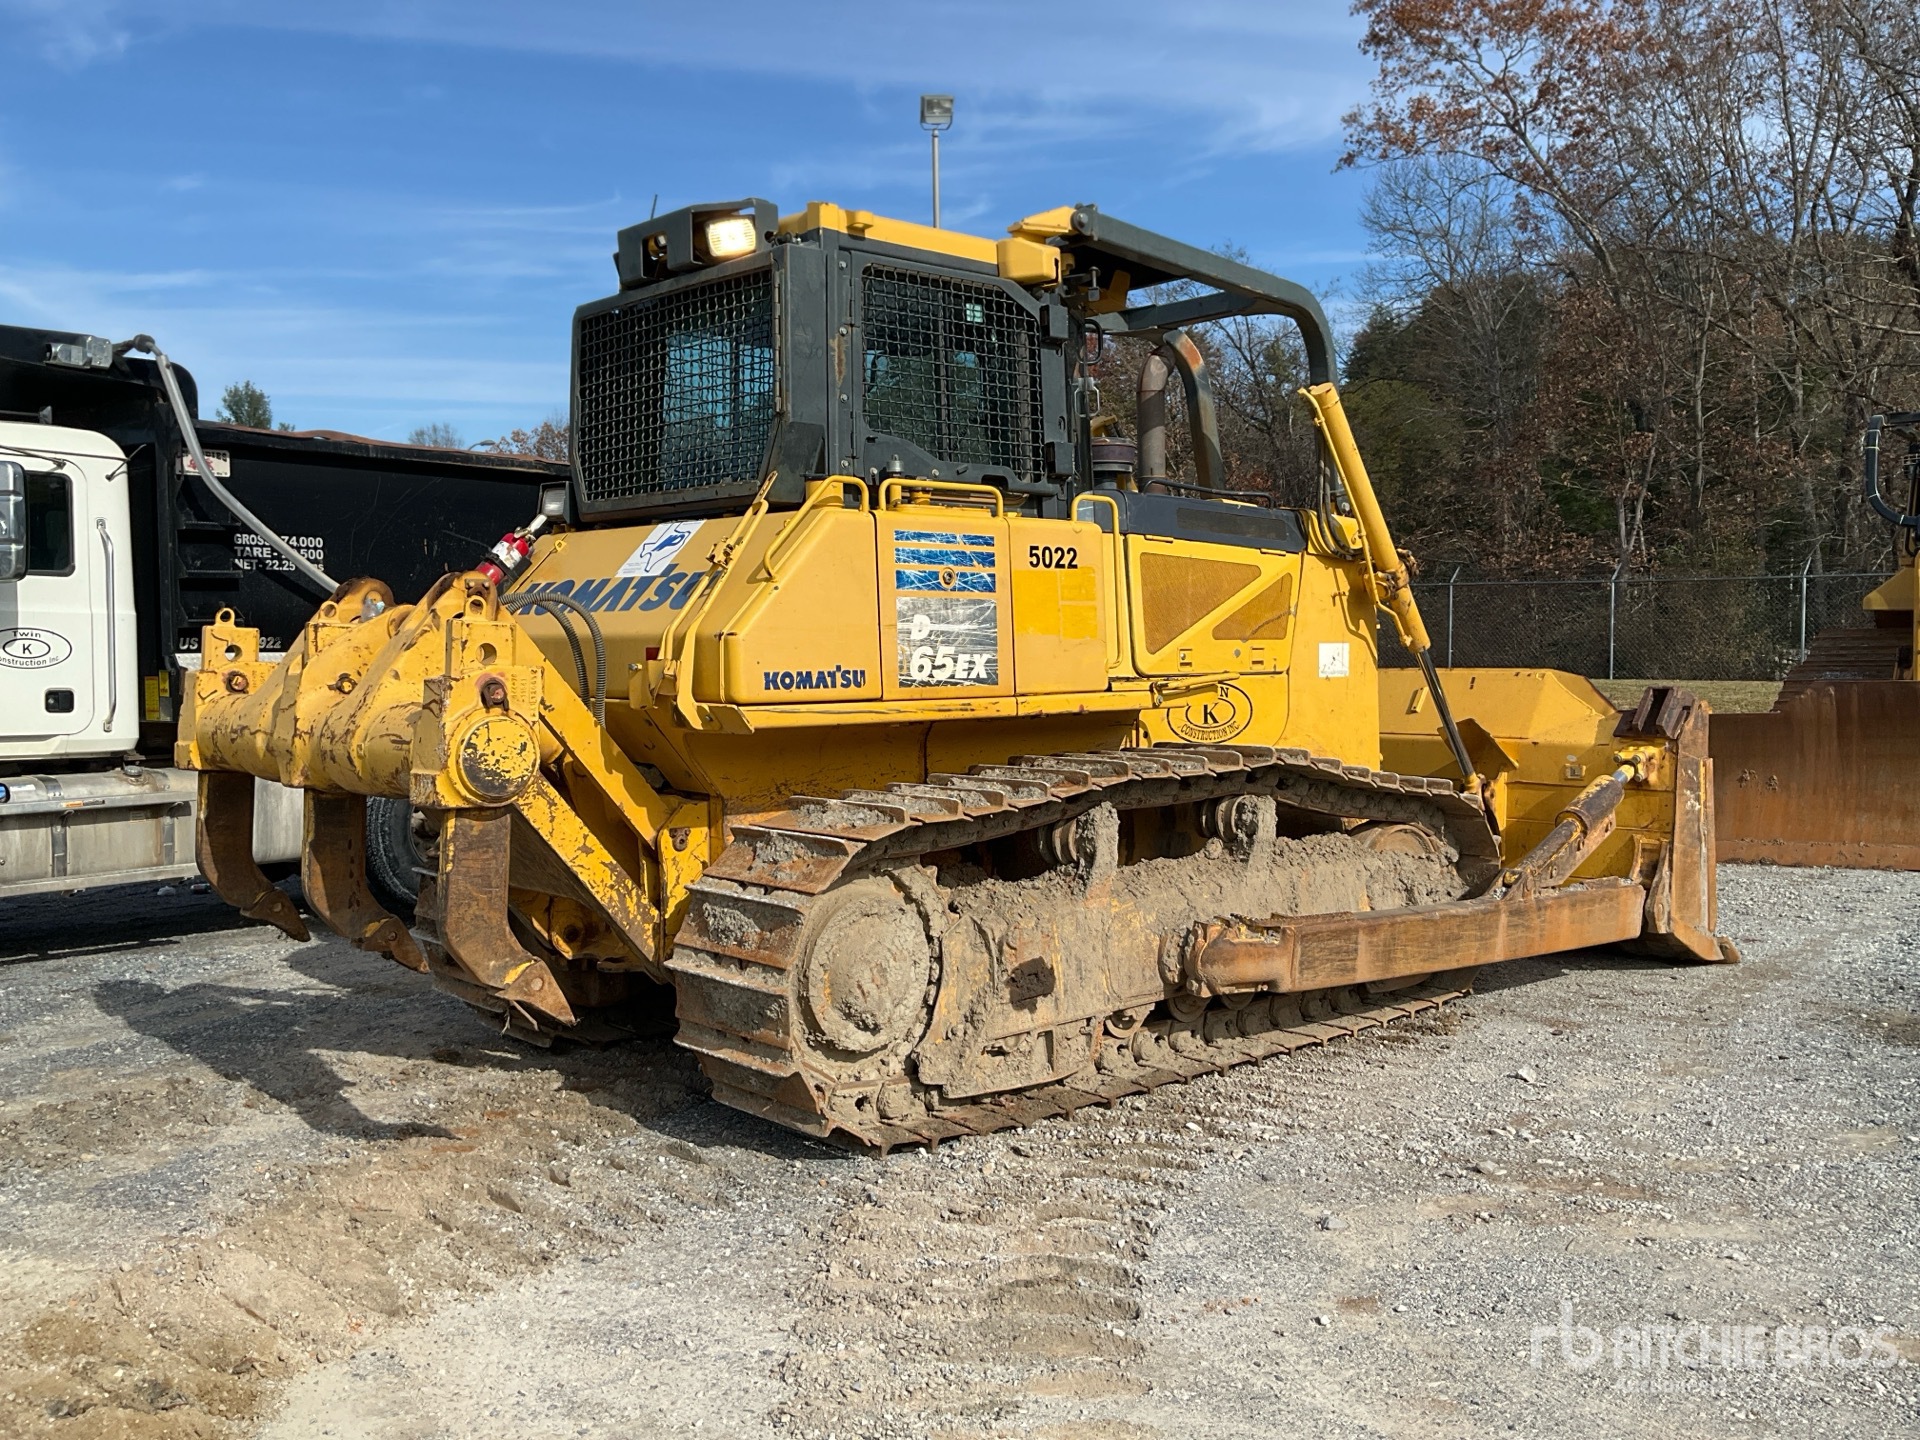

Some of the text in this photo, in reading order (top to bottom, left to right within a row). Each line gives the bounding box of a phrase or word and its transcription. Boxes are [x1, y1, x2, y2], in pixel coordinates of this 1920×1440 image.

[265, 560, 296, 571] 22.25
[1029, 545, 1078, 569] 5022
[518, 563, 722, 616] KOMATSU
[12, 630, 42, 638] Twin
[910, 614, 931, 640] D
[22, 643, 33, 655] K
[0, 656, 47, 667] nstruction
[909, 646, 989, 680] 65EX
[763, 664, 867, 691] KOMATSU
[1203, 702, 1220, 725] K
[1180, 722, 1228, 741] CONSTRUCTION
